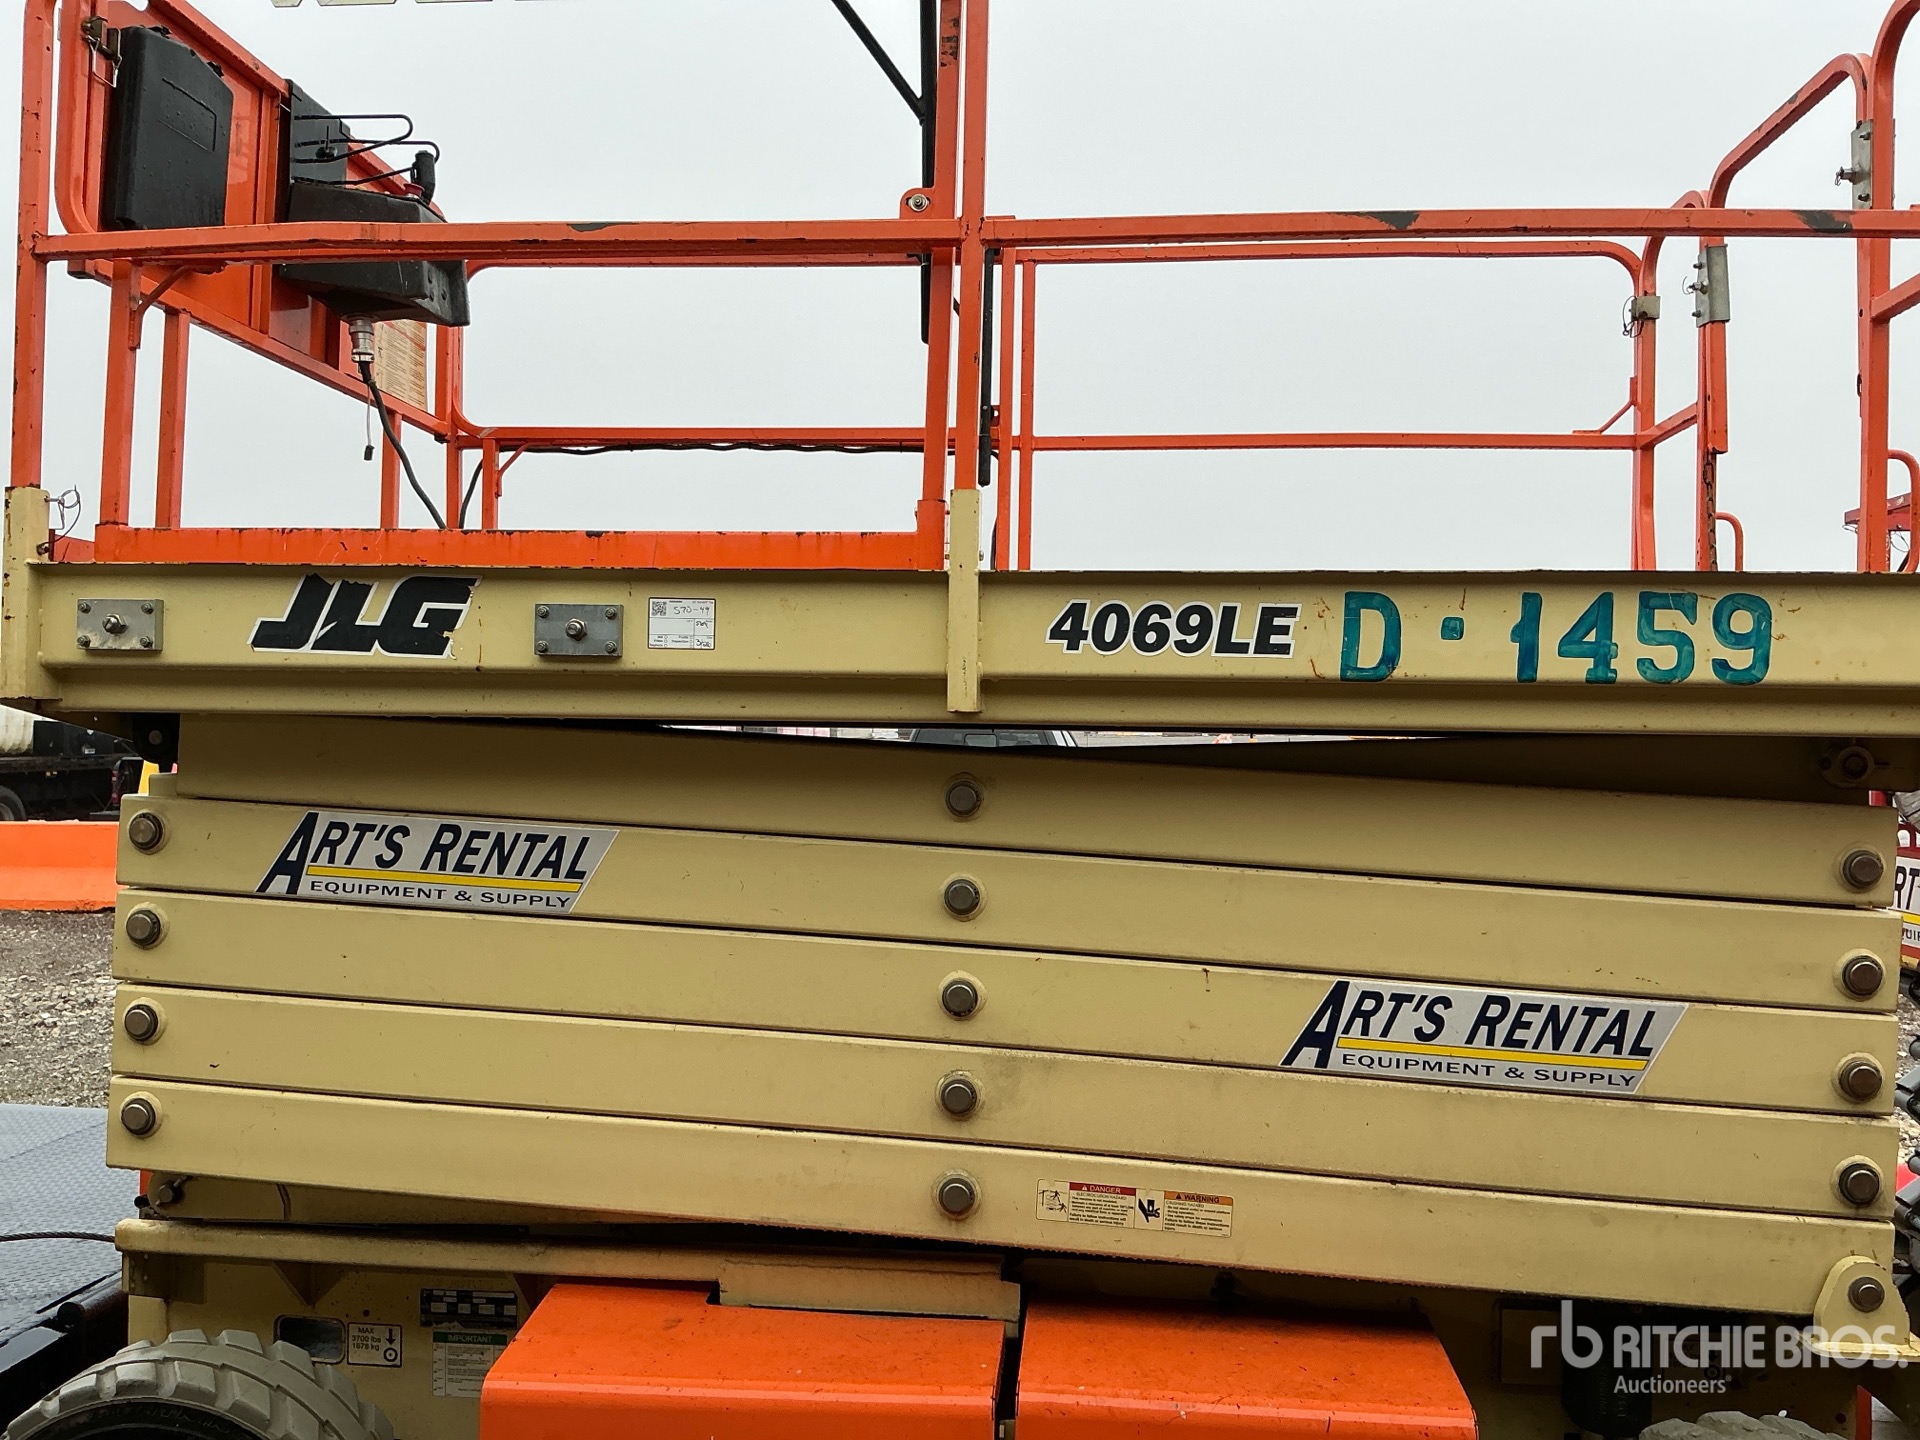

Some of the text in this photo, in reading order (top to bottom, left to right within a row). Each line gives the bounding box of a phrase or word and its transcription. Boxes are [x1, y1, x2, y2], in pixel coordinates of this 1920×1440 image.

[248, 572, 481, 658] JLG
[1046, 600, 1301, 657] 4069LE
[1510, 591, 1772, 685] 1459
[256, 811, 591, 895] ART'S RENTAL
[310, 880, 571, 908] EQUIPMENT & SUPPLY
[1280, 980, 1656, 1069] ART'S RENTAL
[1341, 1053, 1636, 1088] EQUIPMENT & SUPPLY
[1089, 1185, 1121, 1194] DANGER
[1183, 1193, 1220, 1204] WARNING
[447, 1334, 493, 1343] IMPORTANT
